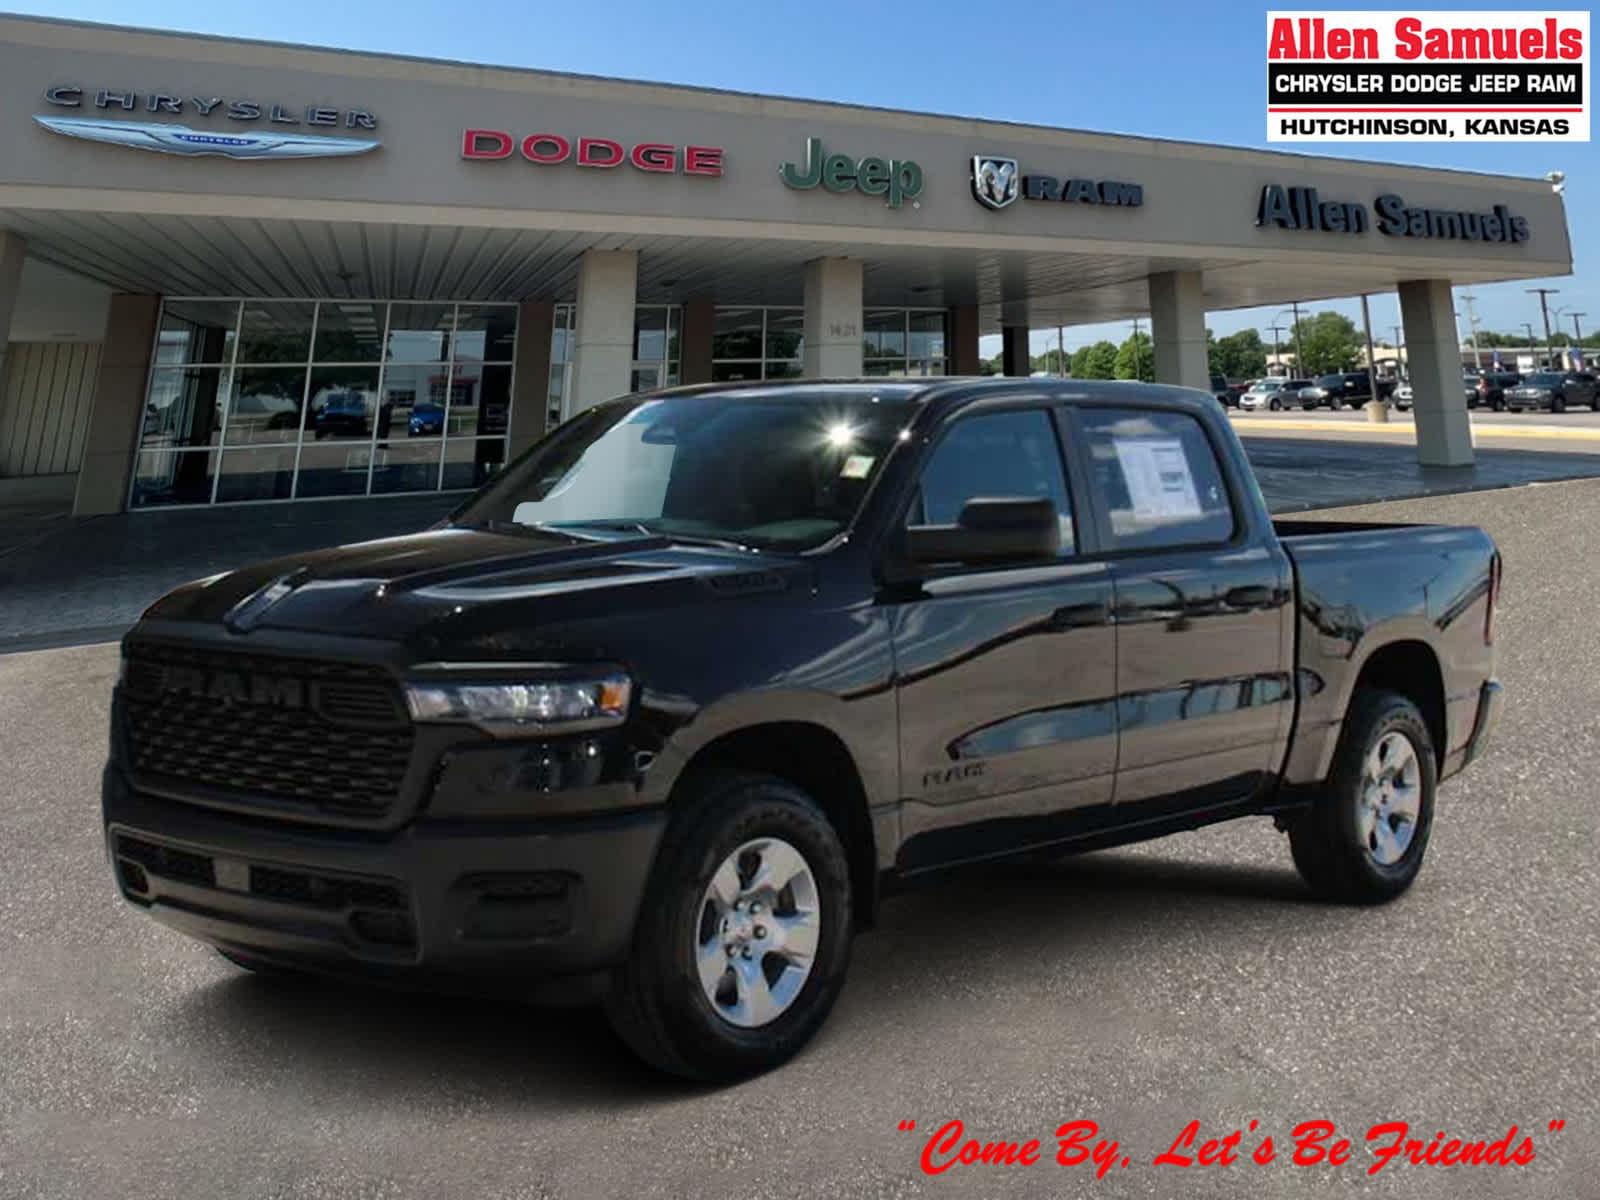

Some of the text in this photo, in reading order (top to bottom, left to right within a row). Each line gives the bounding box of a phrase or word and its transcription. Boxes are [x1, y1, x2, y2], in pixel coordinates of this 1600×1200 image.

[45, 86, 378, 129] CHRYSLER
[461, 128, 725, 177] DODGE
[779, 136, 923, 209] Jeep
[1023, 175, 1144, 207] RAM
[1257, 184, 1531, 243] Allen Samuels
